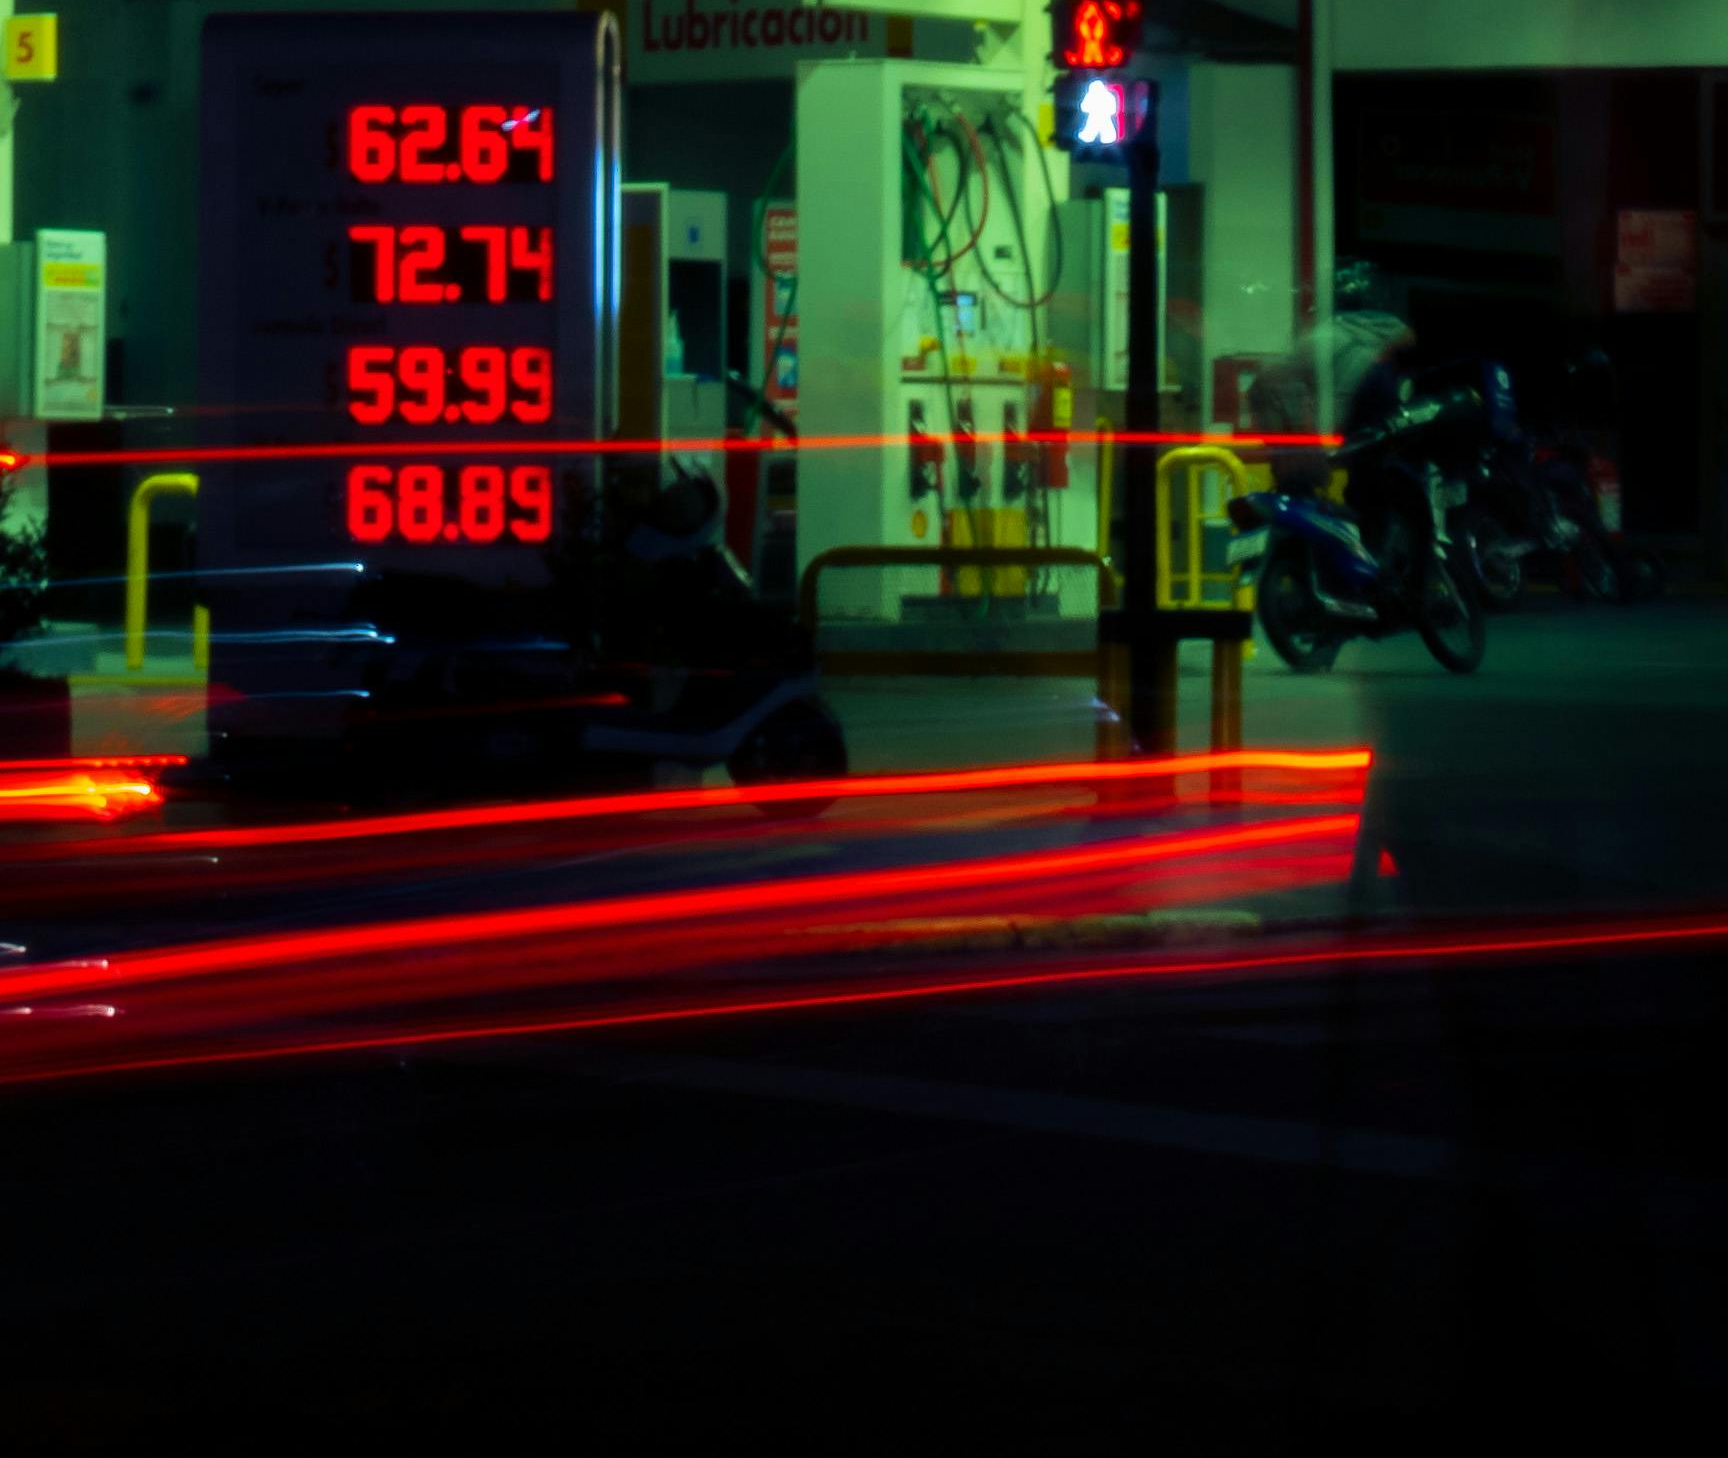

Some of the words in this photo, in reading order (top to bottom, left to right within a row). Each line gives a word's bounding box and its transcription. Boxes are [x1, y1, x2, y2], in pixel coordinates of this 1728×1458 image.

[16, 30, 34, 63] 5
[348, 104, 554, 184] 62.64
[348, 225, 552, 304] 72.74
[347, 345, 553, 425] 59.99
[345, 463, 553, 544] 68.89
